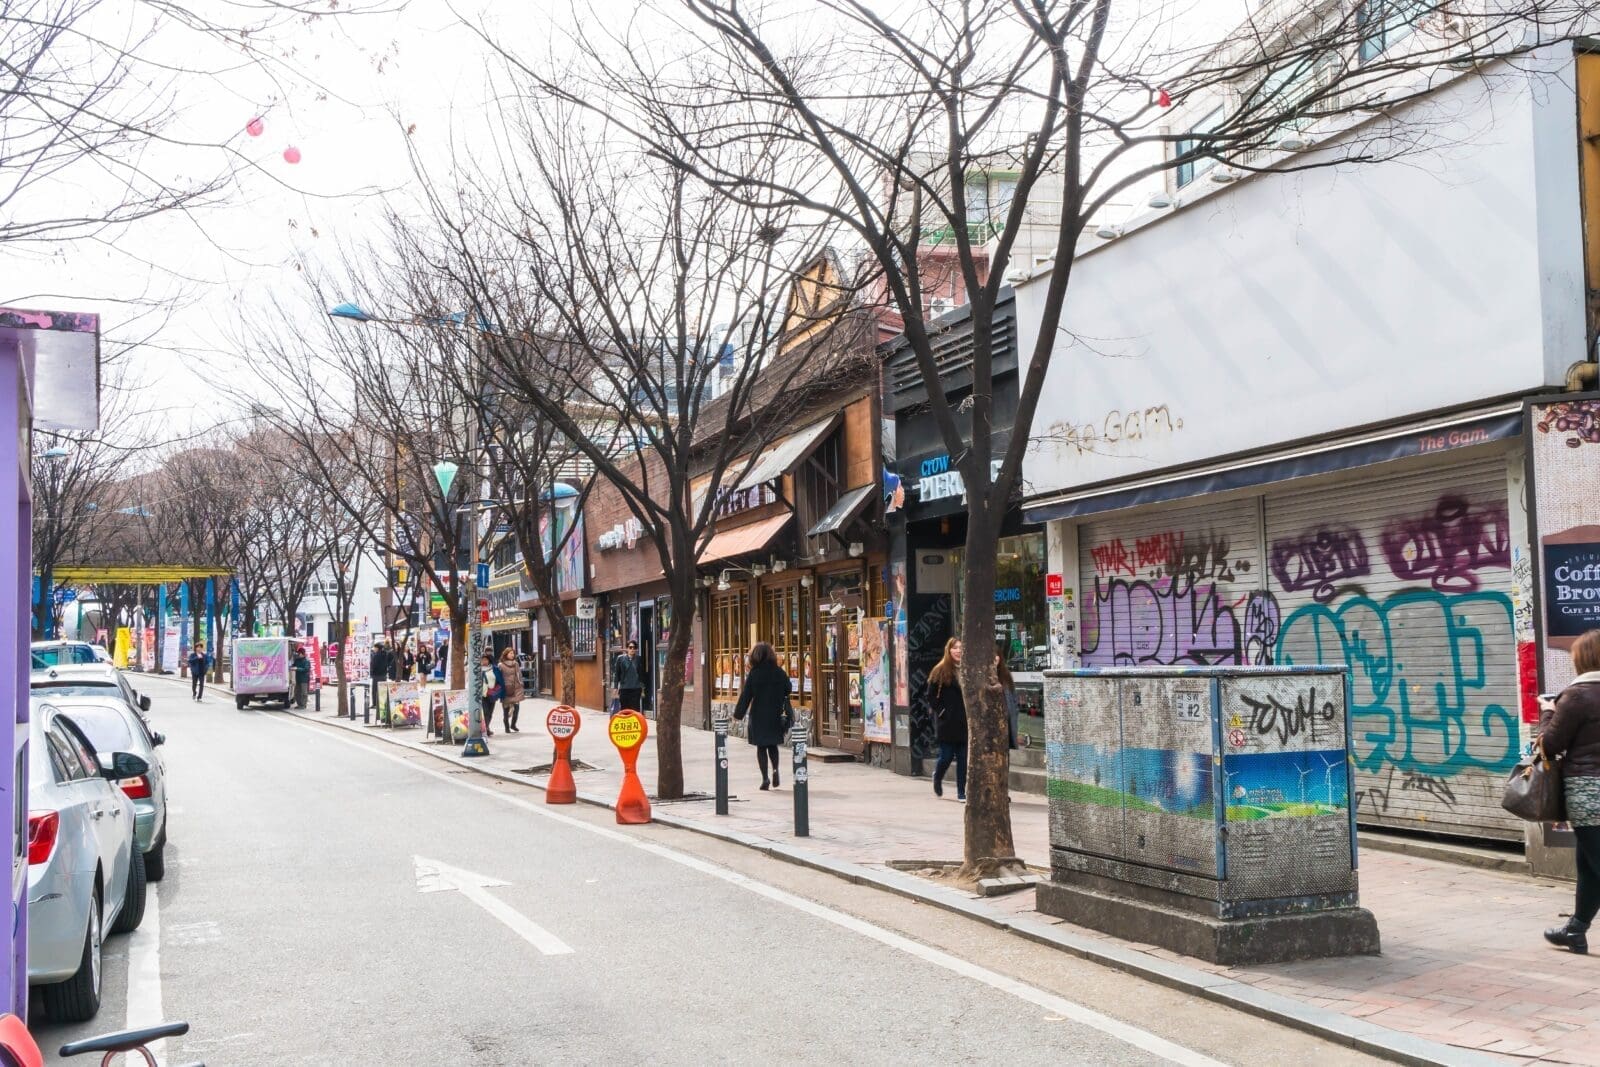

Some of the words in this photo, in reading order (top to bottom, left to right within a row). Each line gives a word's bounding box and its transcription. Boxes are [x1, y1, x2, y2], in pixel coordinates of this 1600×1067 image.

[1419, 436, 1445, 451] The
[1449, 427, 1489, 446] Gam.
[1187, 703, 1200, 717] #2
[551, 714, 573, 724] 주차금지
[614, 721, 639, 731] 주차금지
